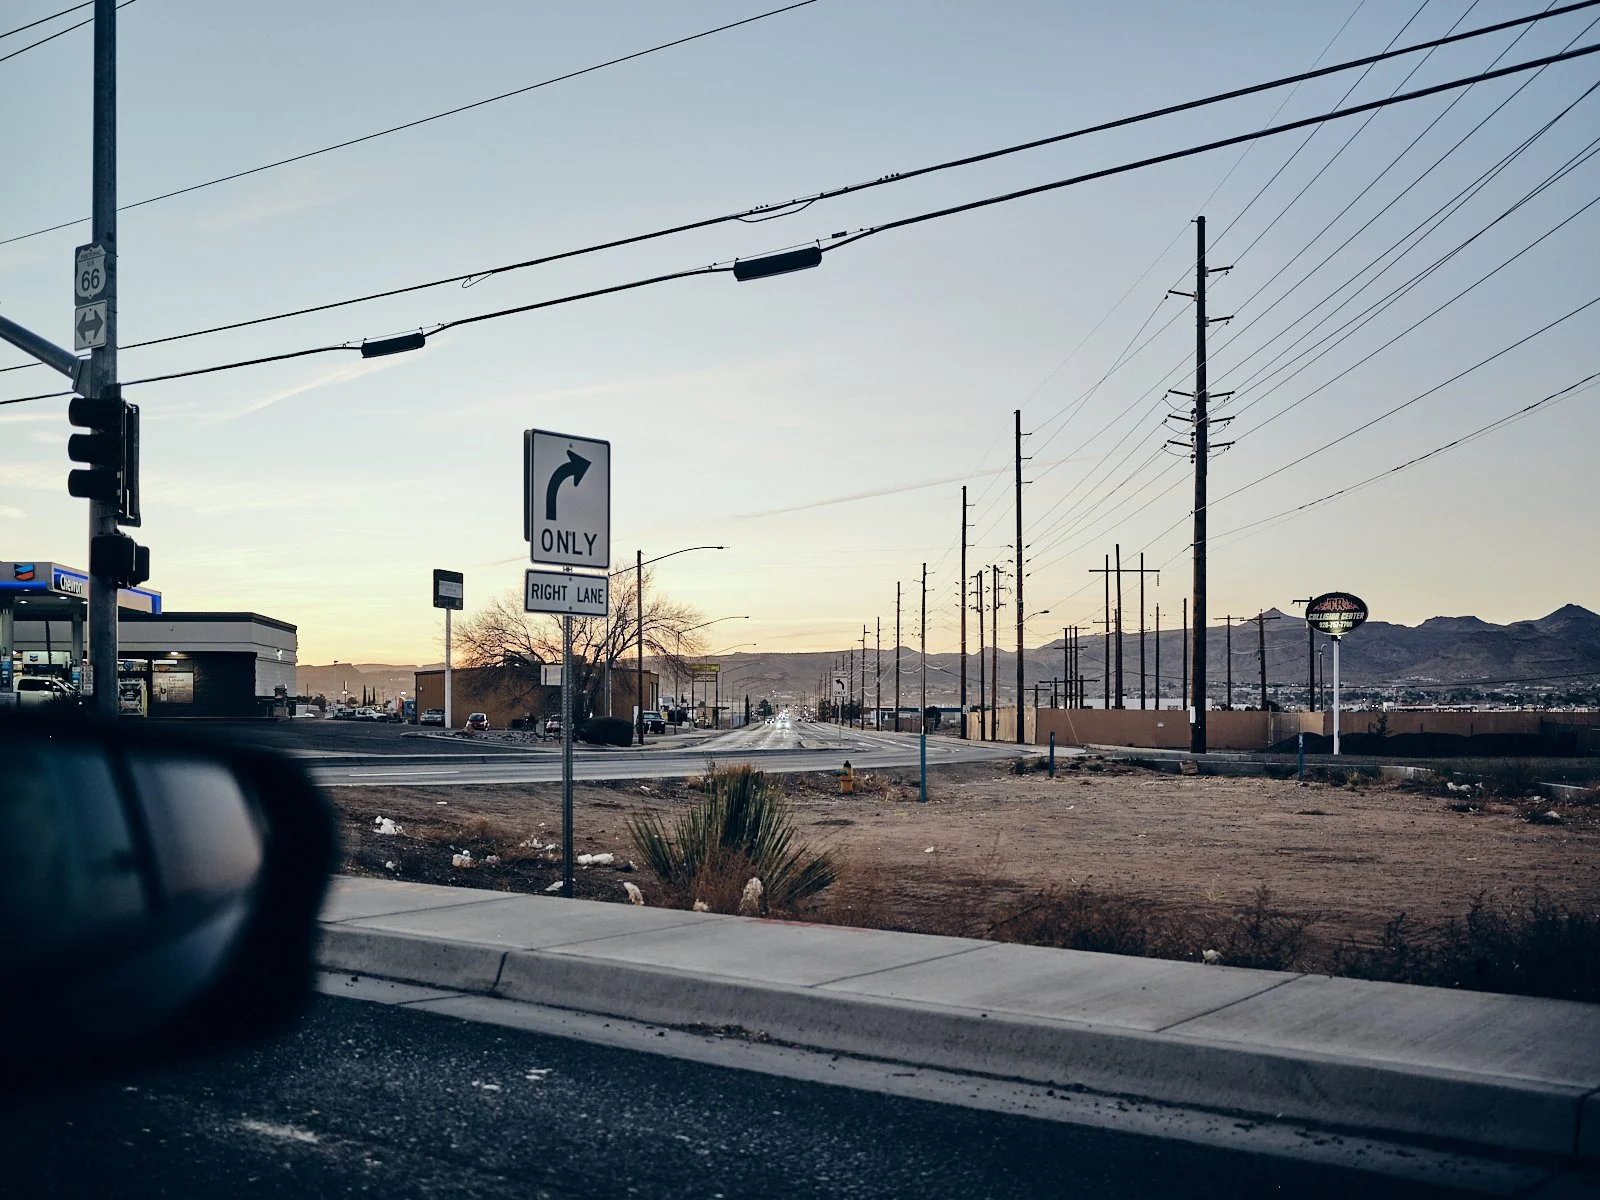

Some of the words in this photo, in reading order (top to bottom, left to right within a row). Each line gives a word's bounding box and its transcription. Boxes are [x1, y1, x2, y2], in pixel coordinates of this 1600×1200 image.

[81, 268, 100, 292] 66
[541, 528, 597, 556] ONLY
[60, 574, 83, 594] Chevron
[531, 583, 567, 601] RIGHT
[577, 586, 604, 605] LANE
[1308, 612, 1340, 620] COLLISION
[1341, 612, 1364, 620] CENTER
